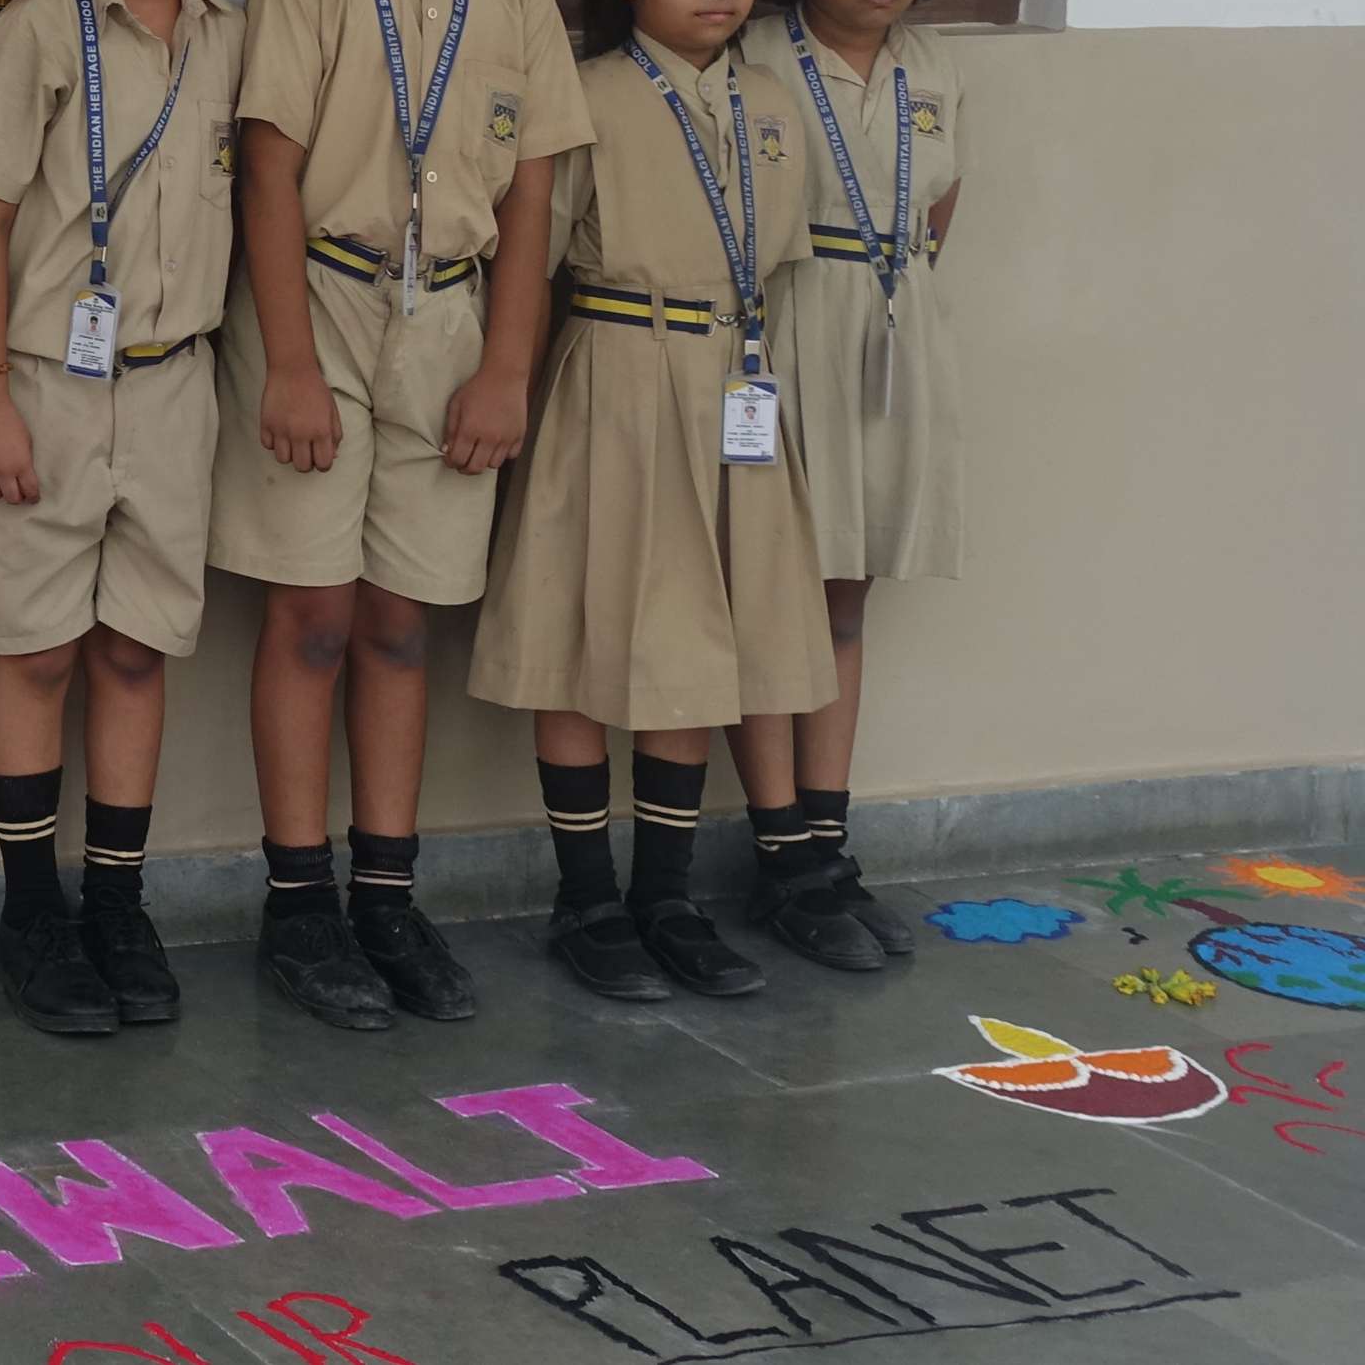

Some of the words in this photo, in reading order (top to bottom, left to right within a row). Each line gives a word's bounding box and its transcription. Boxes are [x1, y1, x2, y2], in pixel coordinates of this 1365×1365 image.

[382, 9, 404, 73] HERITAGE
[86, 44, 101, 112] HERITAGE
[394, 76, 408, 121] INDIAN
[415, 119, 431, 144] THE
[424, 76, 444, 121] INDIAN
[437, 13, 463, 76] HERITAGE
[805, 65, 830, 114] SCHOOL
[91, 115, 103, 163] INDIAN
[673, 100, 700, 151] SCHOOL
[733, 104, 748, 155] SCHOOL
[823, 115, 852, 177] HERITAGE
[93, 165, 104, 193] THE
[899, 126, 910, 188] HERITAGE
[695, 153, 727, 215] HERITAGE
[845, 179, 867, 222] INDIAN
[897, 191, 909, 233] INDIAN
[718, 217, 740, 262] INDIAN
[498, 1188, 1191, 1356] PLANET
